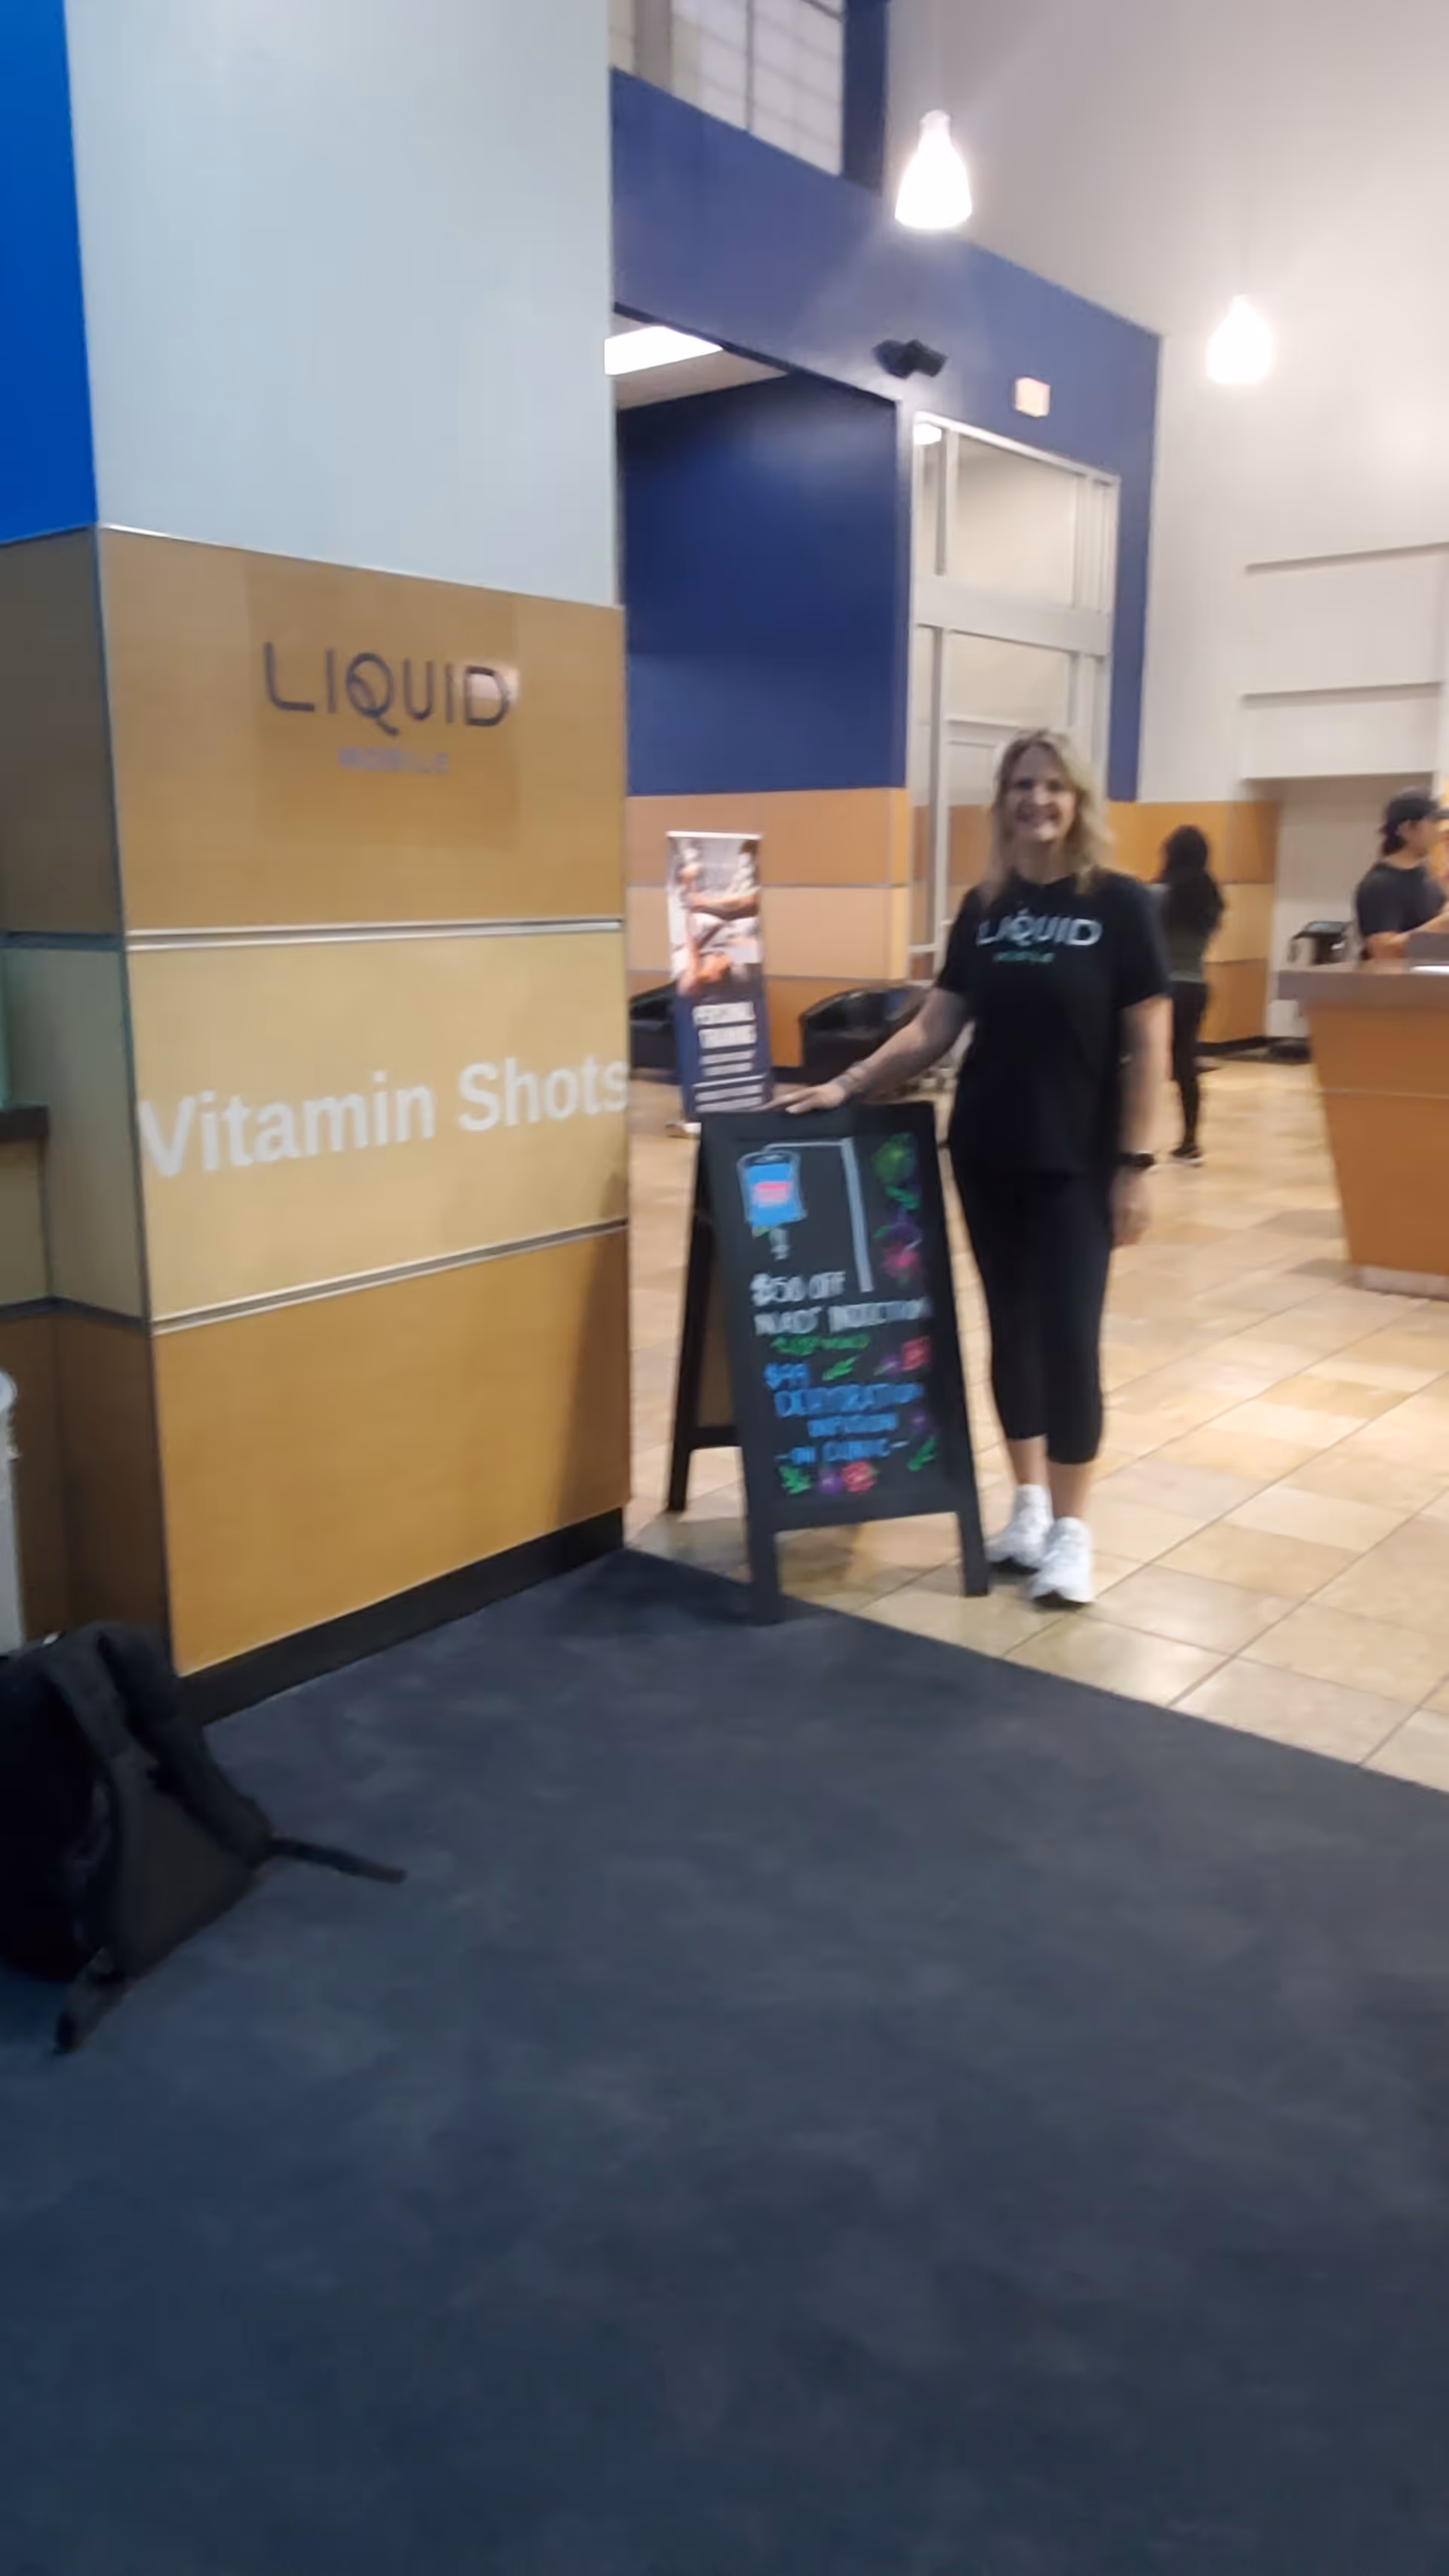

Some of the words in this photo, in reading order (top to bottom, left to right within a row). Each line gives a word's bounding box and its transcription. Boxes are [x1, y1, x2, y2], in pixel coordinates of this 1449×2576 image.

[264, 642, 510, 737] LIQUID
[976, 909, 1103, 947] LIQUID
[138, 1069, 437, 1178] Vitamin
[457, 1054, 628, 1131] Shots
